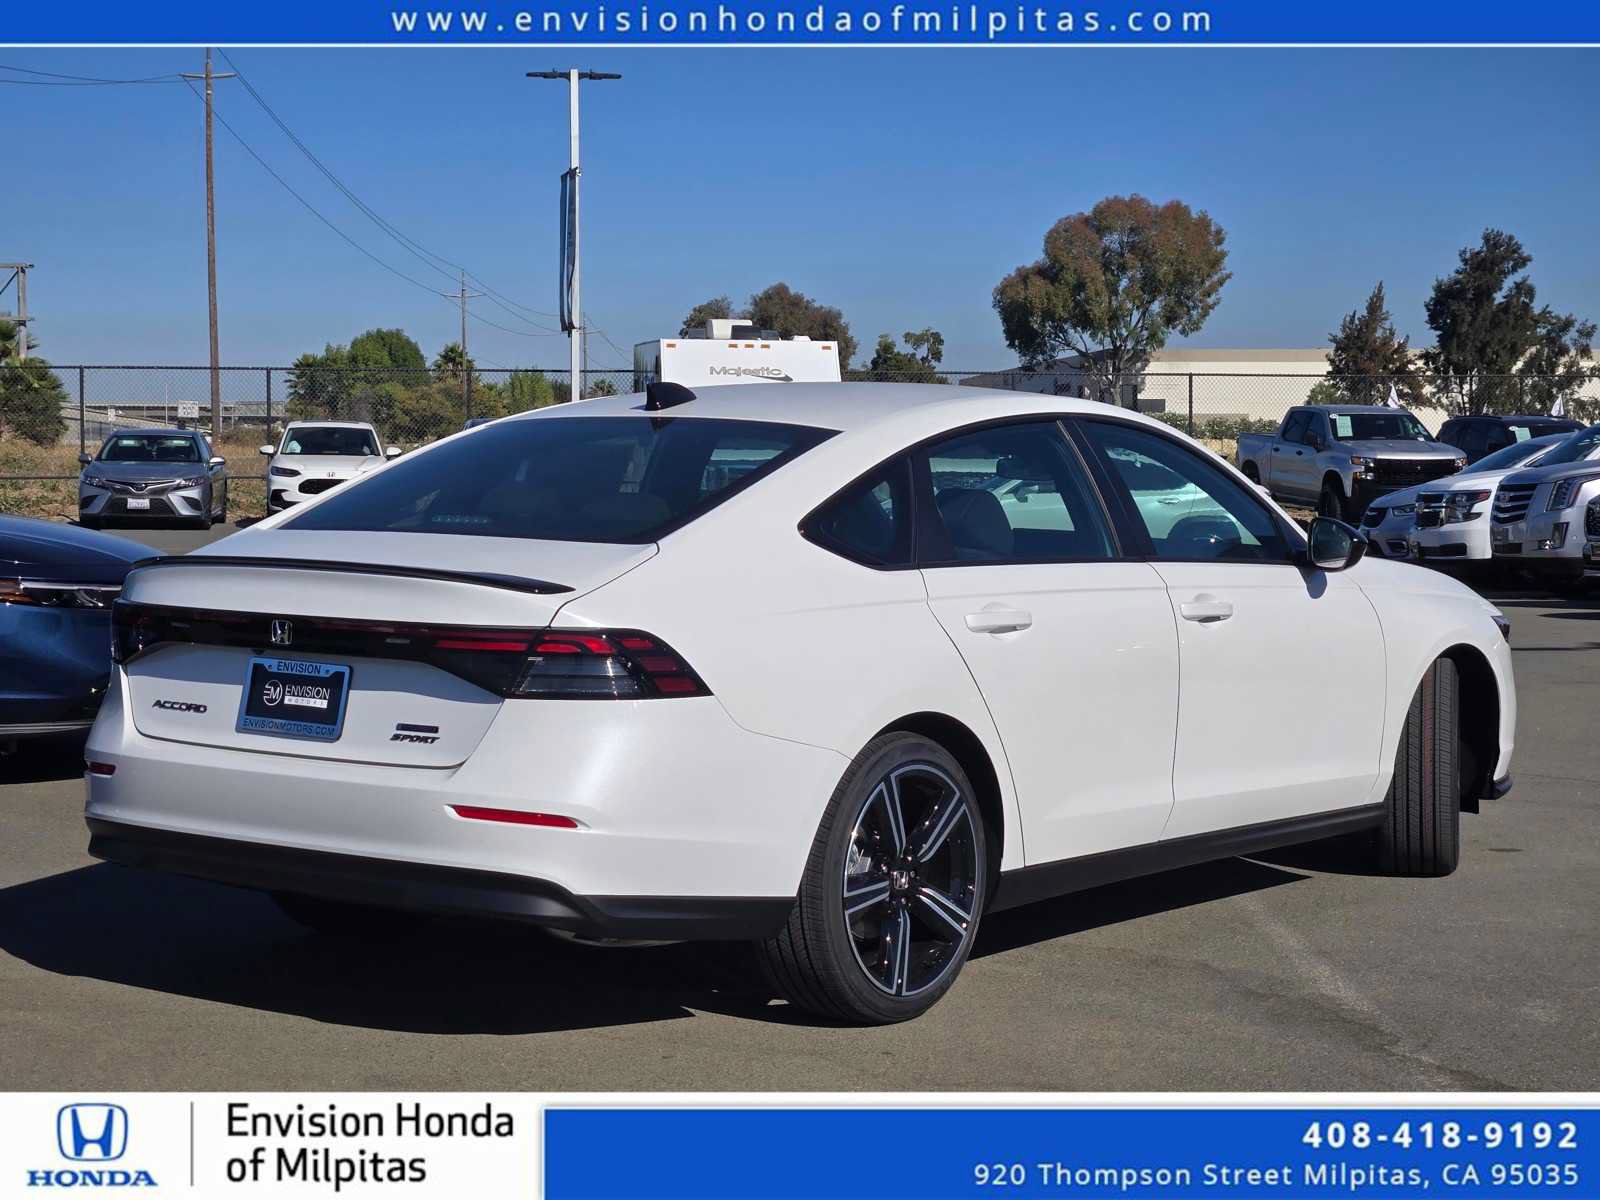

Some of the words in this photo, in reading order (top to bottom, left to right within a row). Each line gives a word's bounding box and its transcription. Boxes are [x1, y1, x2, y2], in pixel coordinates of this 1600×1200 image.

[709, 366, 782, 377] Majestic
[277, 661, 321, 674] ENVISION
[285, 684, 330, 700] ENVISION
[152, 699, 207, 714] ACCORD
[243, 718, 335, 737] ENVISIONMOTORS.COM
[390, 733, 440, 744] SPORT
